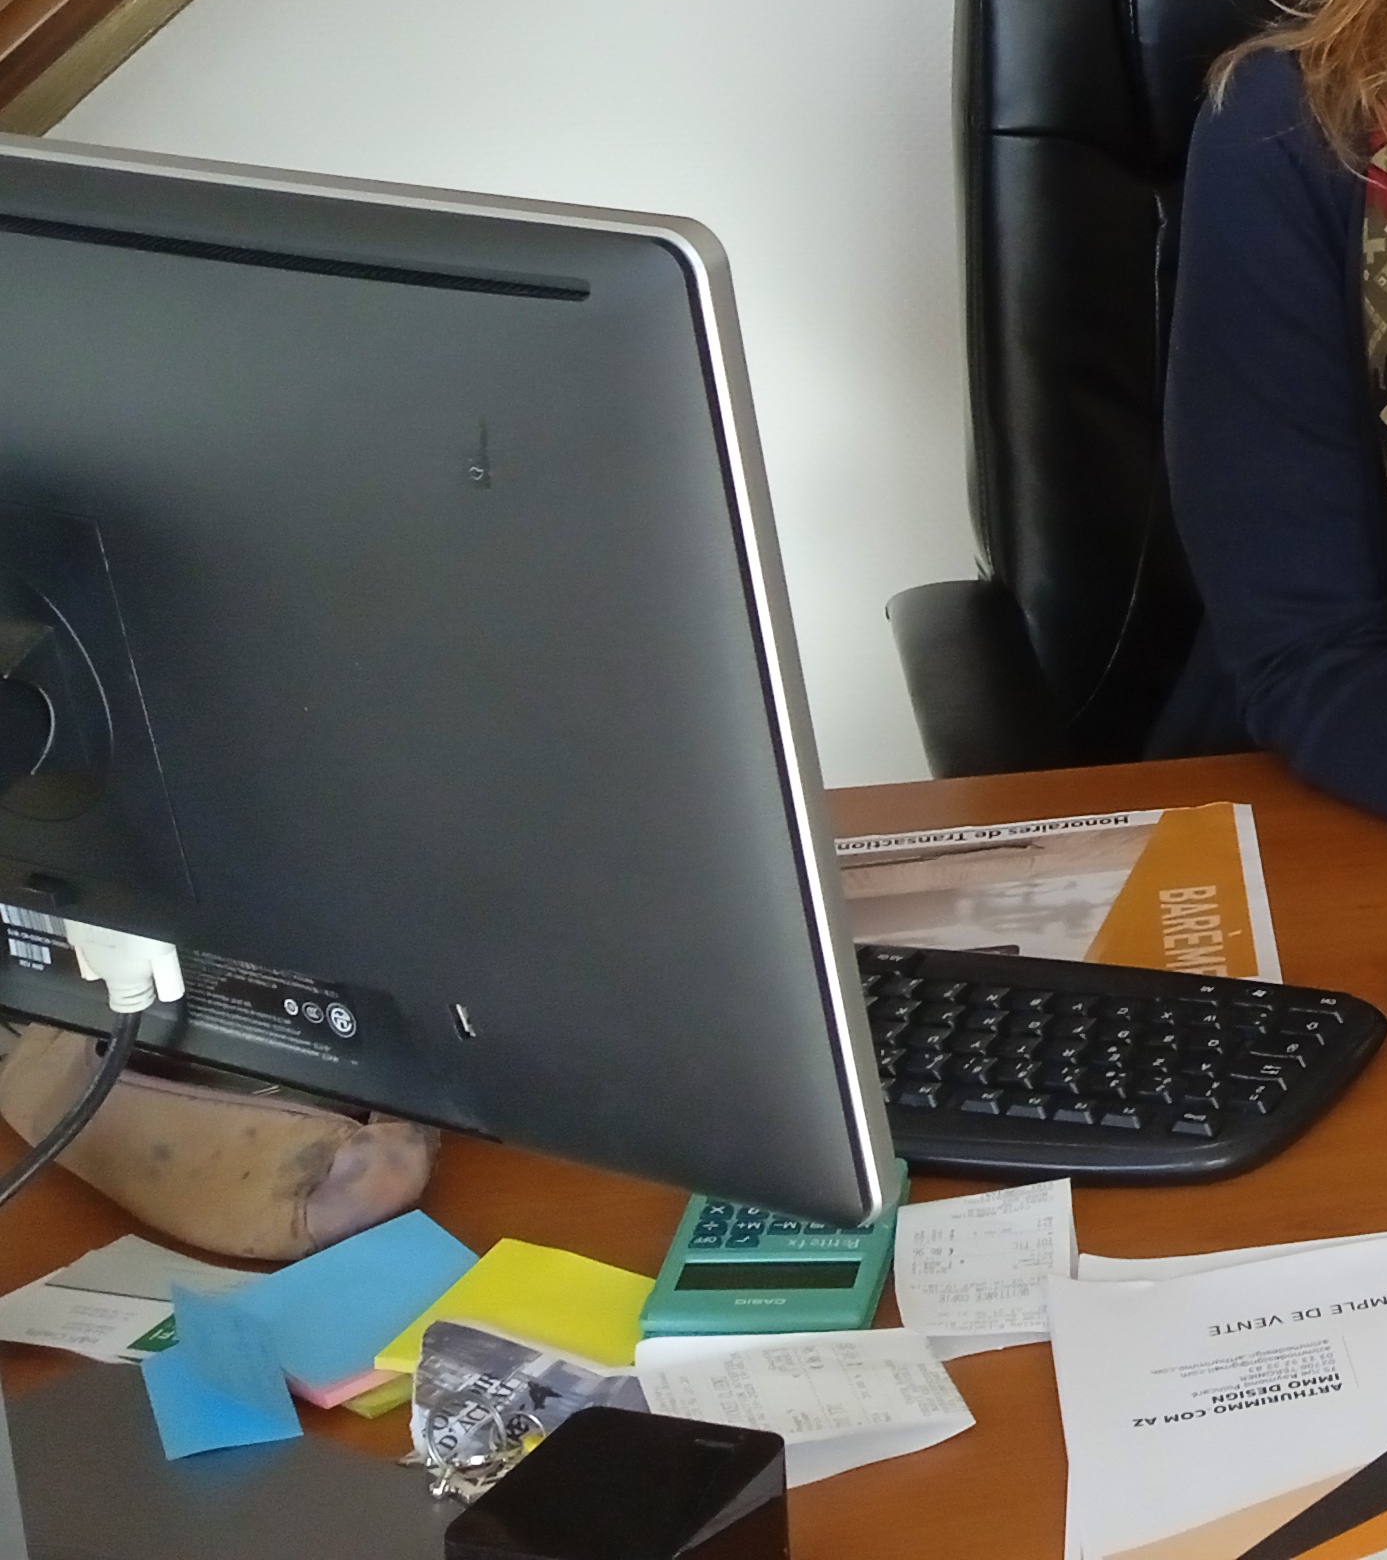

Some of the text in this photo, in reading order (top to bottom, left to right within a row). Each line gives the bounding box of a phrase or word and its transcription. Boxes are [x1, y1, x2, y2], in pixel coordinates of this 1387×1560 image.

[836, 815, 1130, 851] Honoraires de Transaction
[693, 1235, 717, 1244] OFF
[734, 1298, 787, 1306] CASIO
[1291, 1306, 1323, 1323] DE
[1207, 1314, 1284, 1338] VENTE
[1211, 1372, 1340, 1405] IMMO DESIGN
[1131, 1416, 1158, 1428] AZ
